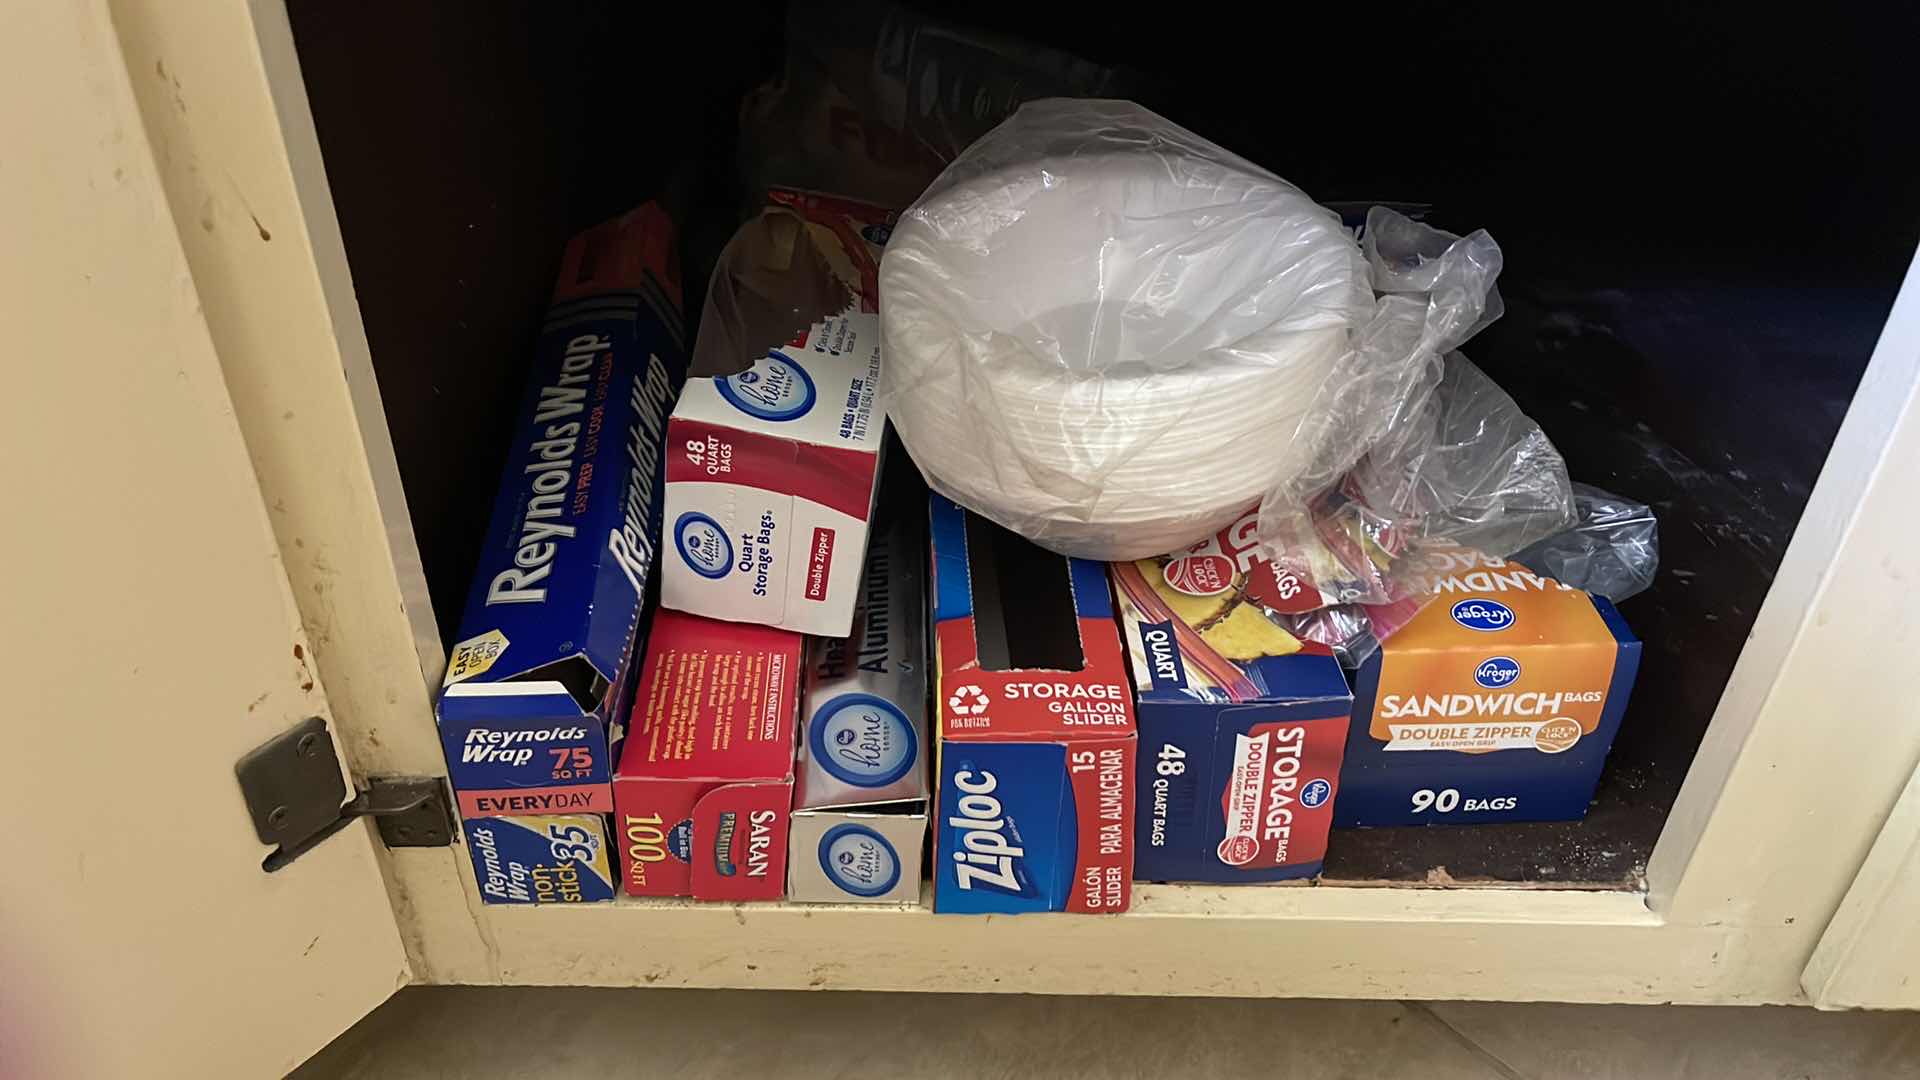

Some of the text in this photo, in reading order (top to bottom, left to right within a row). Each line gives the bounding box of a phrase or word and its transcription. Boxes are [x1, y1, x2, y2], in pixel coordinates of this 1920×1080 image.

[631, 353, 676, 439] Wrap
[739, 365, 787, 407] home
[486, 333, 607, 606] Reynolds Wrap
[687, 440, 706, 466] 48
[707, 435, 720, 475] QUART
[719, 443, 732, 474] BAGS
[608, 426, 658, 599] Reynolds
[694, 529, 715, 568] home
[738, 533, 754, 573] Quart
[810, 532, 829, 597] Double Zipper
[752, 547, 773, 597] Storage
[857, 554, 889, 675] Aluminum
[1456, 604, 1511, 624] Kroger
[453, 646, 471, 677] EASY
[1145, 630, 1178, 682] QUART
[1477, 662, 1519, 683] Kroger
[764, 653, 783, 741] MICROWAVE INSTRUCTIONS
[1004, 683, 1121, 700] STORAGE
[1048, 702, 1125, 714] GALLON
[1381, 691, 1603, 718] SANDWICH BAGS
[465, 727, 588, 746] Reynolds
[838, 711, 882, 769] home
[1063, 714, 1128, 726] SLIDER
[1399, 725, 1533, 741] DOUBLE ZIPPER
[462, 745, 533, 767] Wrap
[548, 747, 593, 770] 75
[551, 768, 592, 780] SQ FT
[1072, 751, 1096, 773] 15
[476, 792, 593, 812] EVERYDAY
[1100, 748, 1123, 855] PARA ALMACENAR
[1152, 743, 1186, 847] 48 QUART BAGS
[1239, 742, 1263, 833] DOUBLE ZIPPER
[1264, 727, 1305, 863] STORAGE BAGS
[1410, 789, 1518, 814] 90 BAGS
[550, 825, 593, 862] 35
[625, 813, 666, 863] 100
[715, 812, 736, 862] PREMIUM
[748, 810, 776, 877] SARAN
[949, 770, 1024, 891] Ziploc
[472, 827, 506, 898] Reynolds
[505, 861, 531, 901] Wrap
[557, 862, 582, 903] stick
[841, 841, 875, 886] home
[1083, 866, 1102, 908] GALÓN
[1107, 867, 1121, 907] SLIDER
